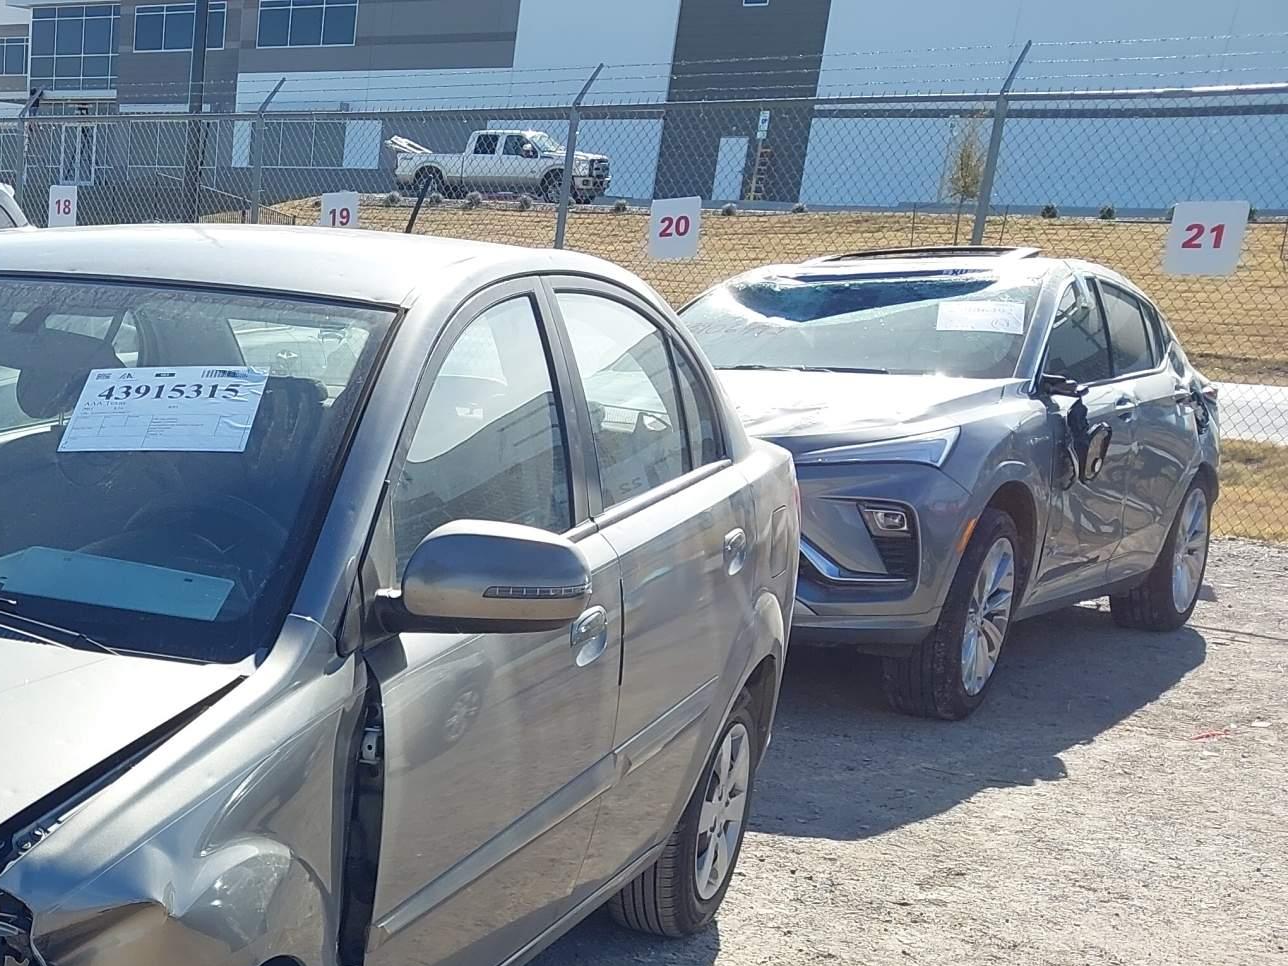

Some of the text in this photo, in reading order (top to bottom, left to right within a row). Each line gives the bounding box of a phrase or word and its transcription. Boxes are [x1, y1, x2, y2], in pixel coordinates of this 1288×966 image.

[55, 199, 71, 215] 18
[328, 207, 350, 228] 19
[659, 215, 690, 237] 20
[1181, 223, 1225, 249] 21
[98, 383, 241, 401] 43915315
